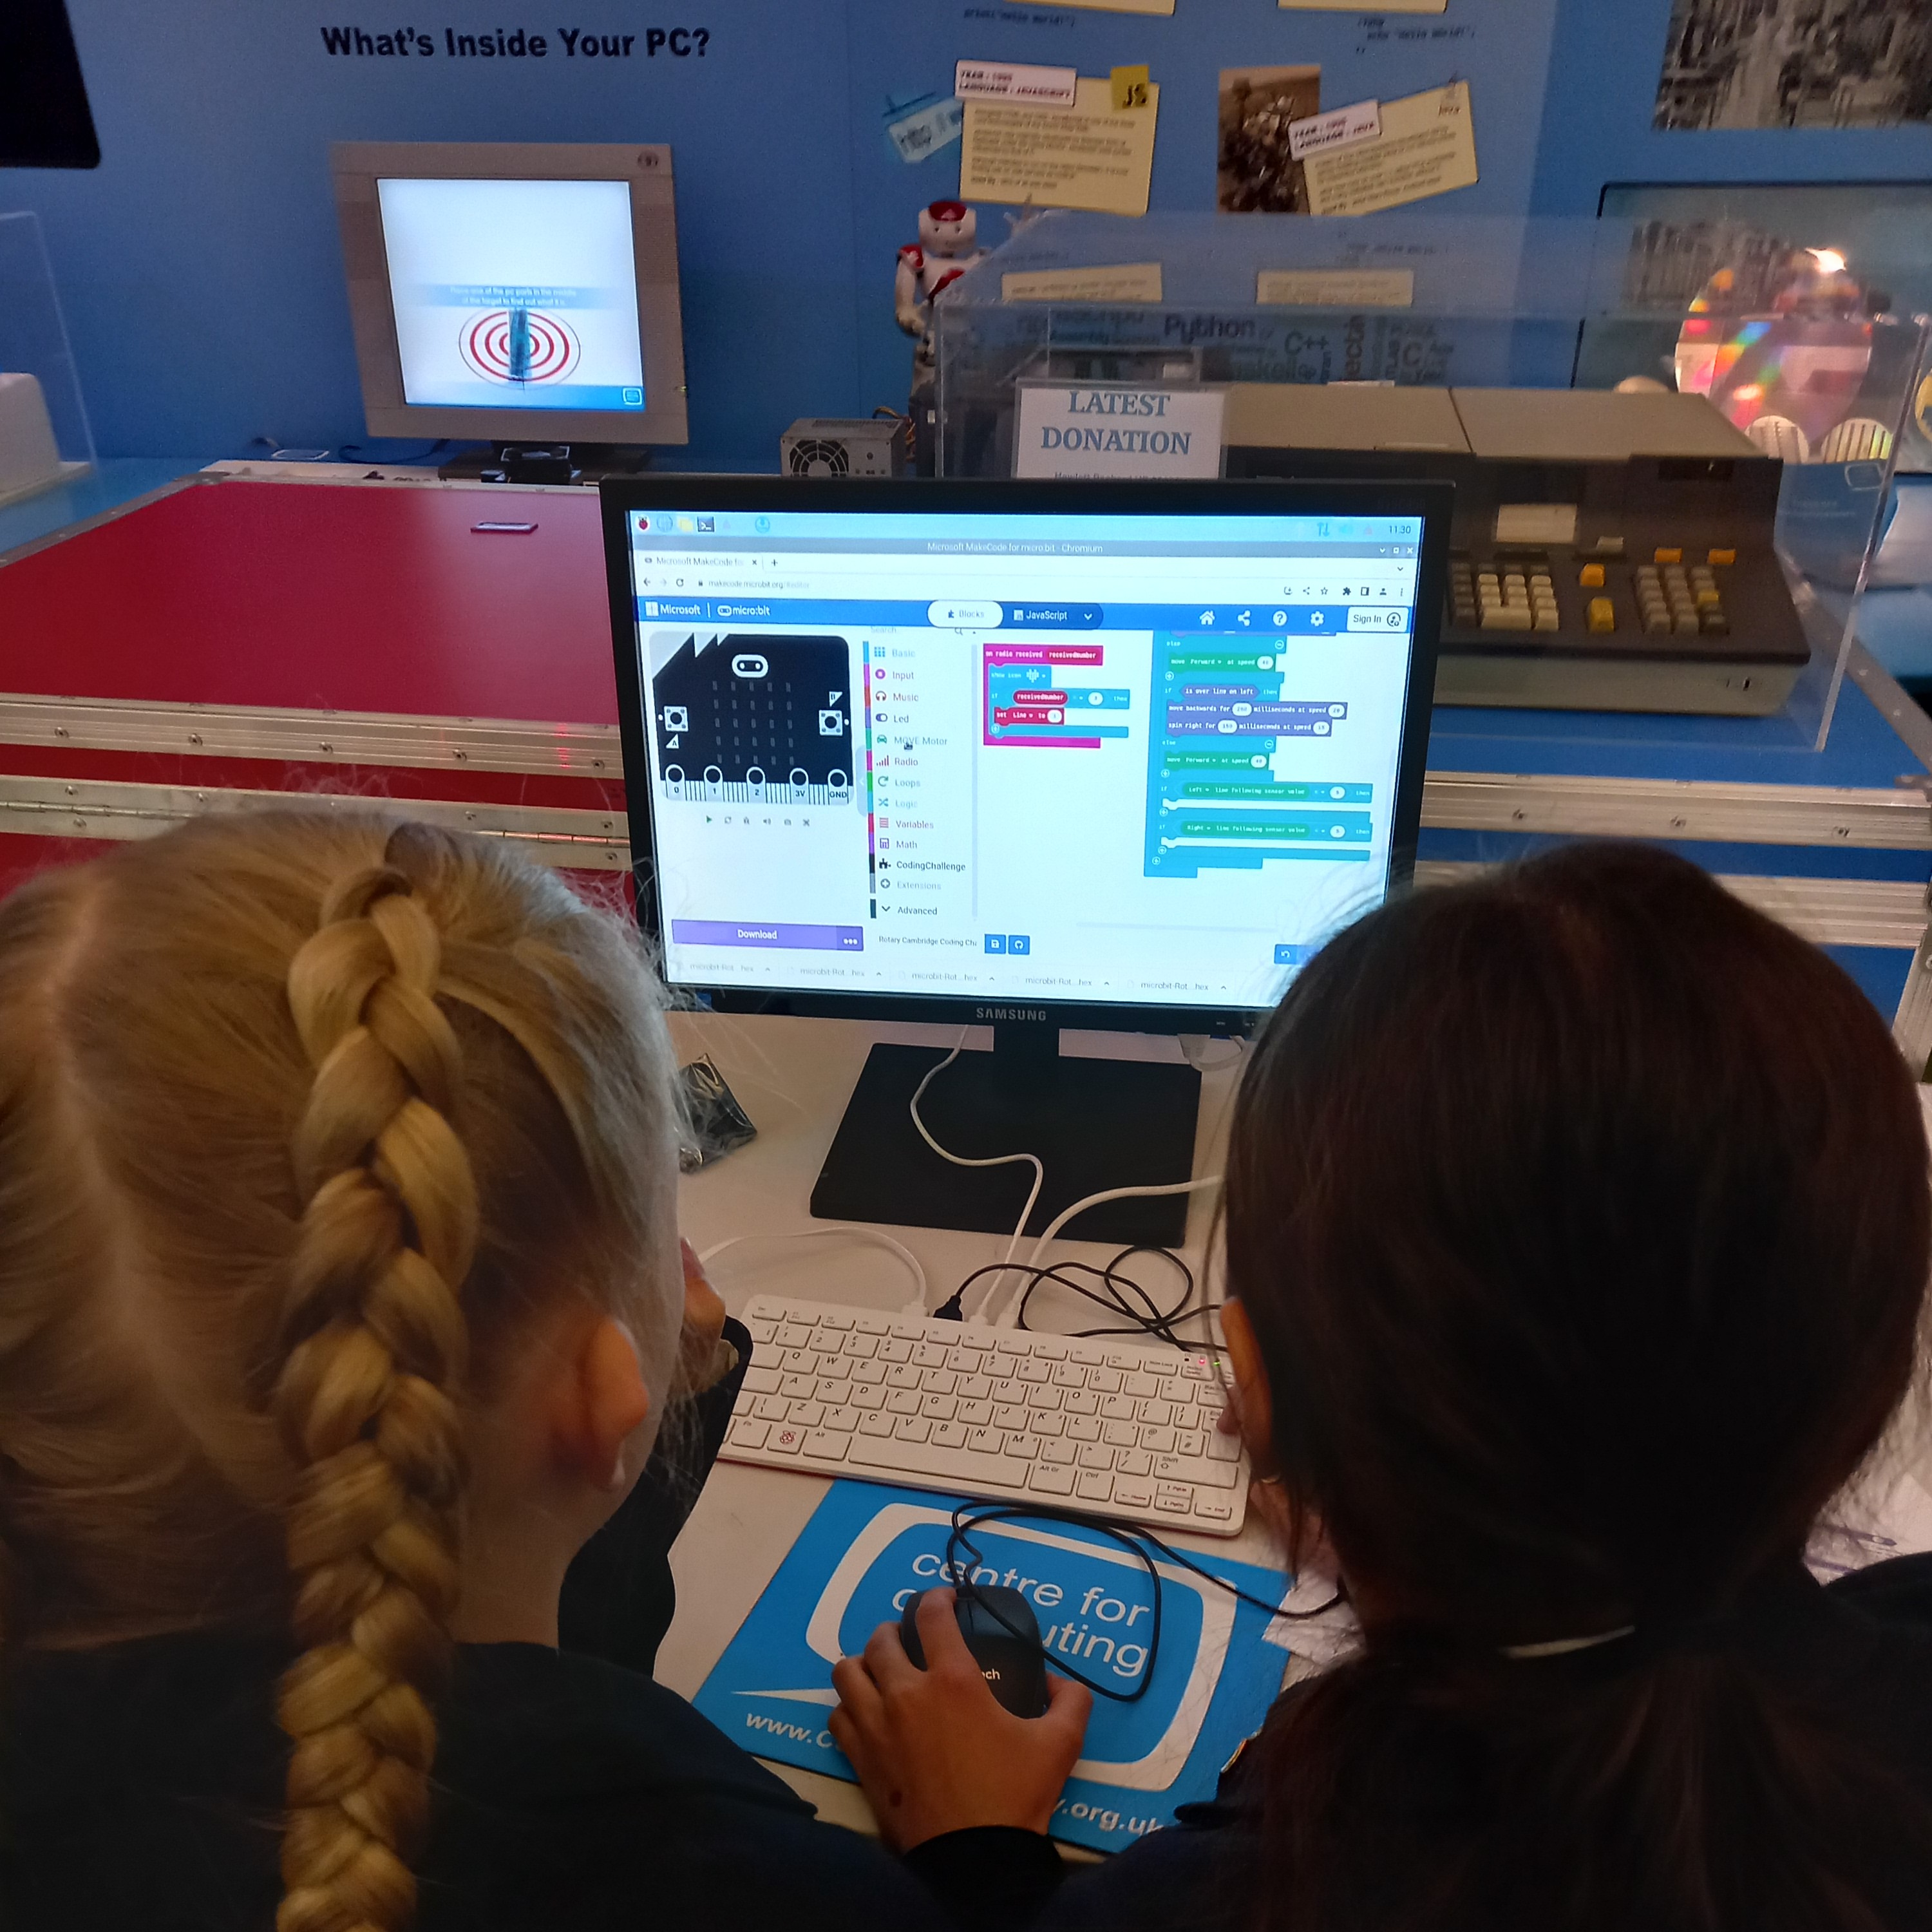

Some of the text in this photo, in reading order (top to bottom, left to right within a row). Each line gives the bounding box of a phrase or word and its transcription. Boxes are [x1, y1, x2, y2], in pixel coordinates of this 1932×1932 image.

[321, 26, 710, 57] What's Inside Your PC?
[1122, 82, 1148, 109] JS
[1164, 312, 1255, 345] Python
[1068, 390, 1171, 417] LATEST
[1041, 426, 1191, 455] DONATION
[927, 542, 963, 551] Microsoft
[966, 543, 1007, 552] MakeCode
[1009, 543, 1020, 552] for
[1061, 544, 1103, 553] Chromium
[656, 557, 692, 565] Microsoft
[693, 557, 733, 566] MakeCode
[660, 604, 701, 615] Microsoft
[733, 605, 771, 616] micro:bit
[959, 610, 985, 619] Blocks
[1026, 611, 1068, 622] JavaScript
[1353, 614, 1382, 625] Sign In
[892, 649, 916, 658] Basic
[1016, 650, 1043, 659] received
[1238, 658, 1256, 667] speed
[893, 671, 914, 681] Input
[893, 693, 919, 702] Music
[1253, 705, 1296, 714] milliseconds
[1308, 706, 1327, 715] speed
[894, 715, 909, 723] Led
[1185, 722, 1203, 730] right
[1238, 722, 1281, 730] milliseconds
[1293, 723, 1312, 732] speed
[894, 736, 947, 746] MOVE Motor
[895, 757, 918, 766] Radio
[895, 779, 921, 789] Loops
[1231, 787, 1262, 795] following
[895, 799, 917, 810] Logic
[896, 820, 934, 829] Variables
[1232, 826, 1263, 834] following
[896, 840, 918, 849] Math
[896, 860, 966, 873] CodingChallenge
[897, 881, 942, 891] Extensions
[898, 906, 938, 916] Advanced
[737, 929, 778, 940] Download
[878, 936, 901, 945] Rotary
[902, 936, 939, 946] Cambridge
[940, 938, 964, 947] Coding
[976, 1007, 1047, 1022] SAMSUNG
[791, 1352, 800, 1360] Q
[826, 1356, 838, 1365] W
[895, 1391, 903, 1399] F
[832, 1408, 842, 1417] X
[1001, 1406, 1010, 1415] J
[1037, 1412, 1047, 1420] K
[940, 1424, 949, 1432] B
[976, 1429, 986, 1437] N
[1162, 1455, 1179, 1464] Shift
[912, 1553, 1151, 1627] centre for
